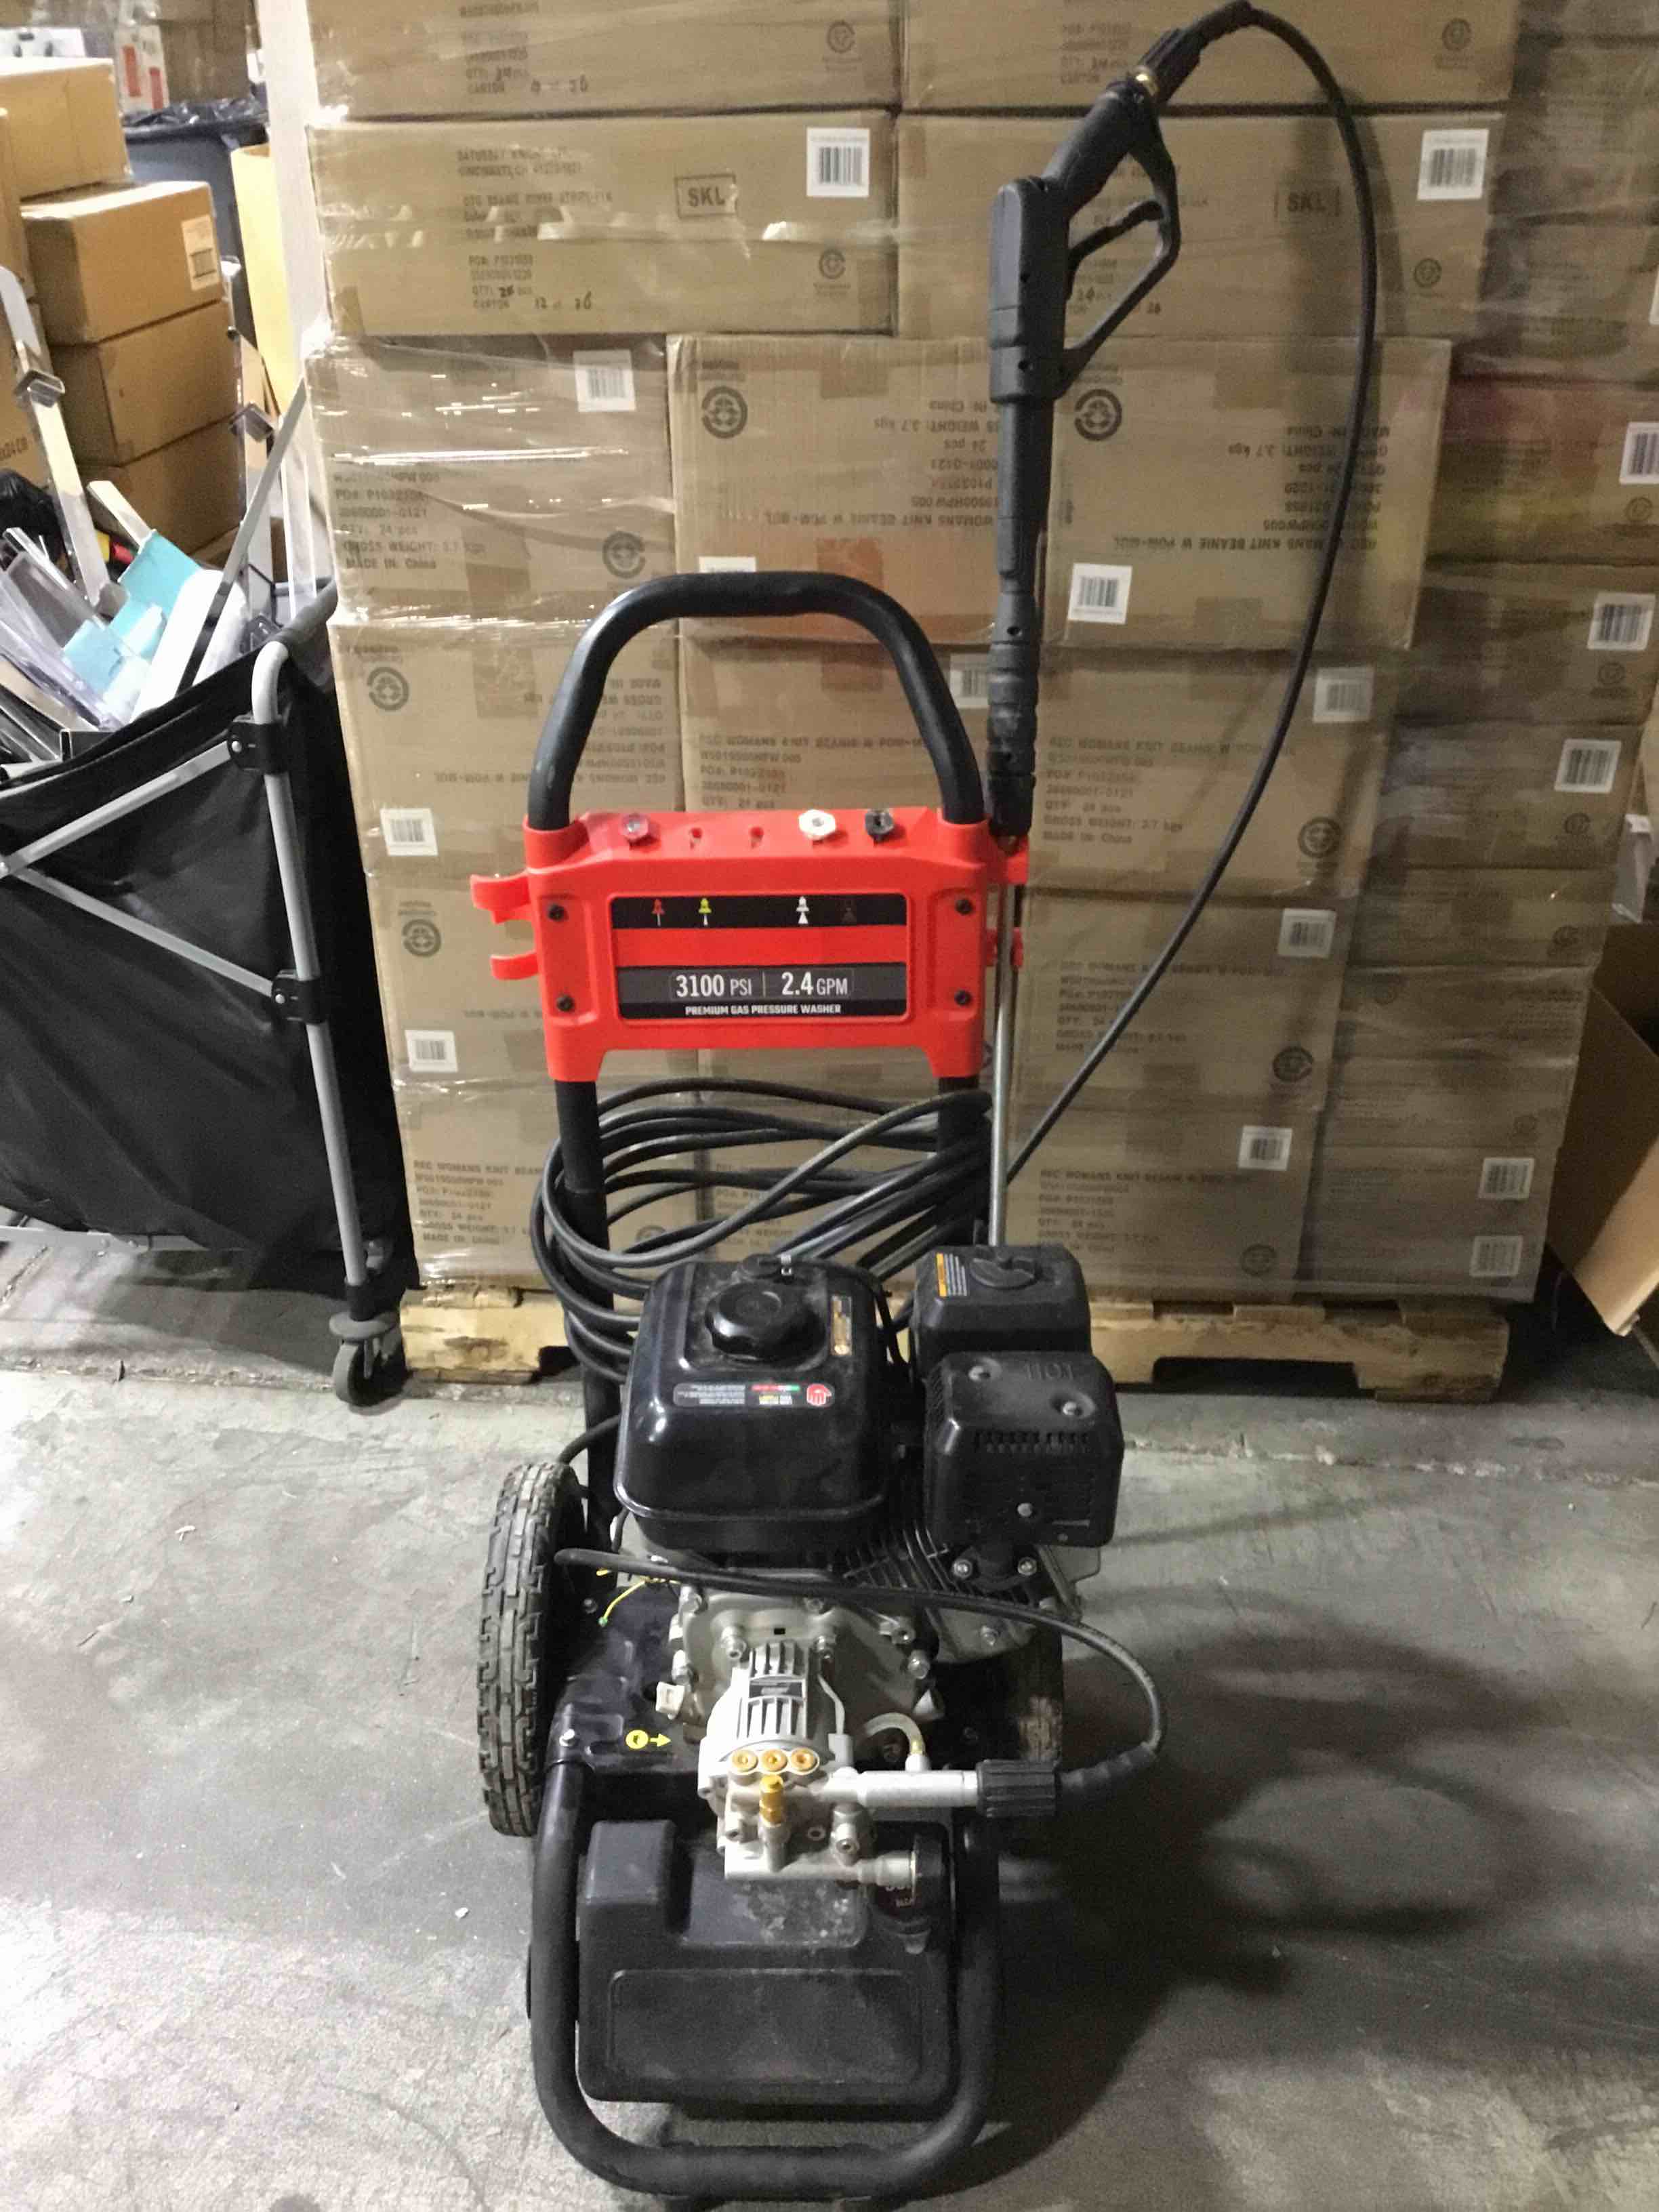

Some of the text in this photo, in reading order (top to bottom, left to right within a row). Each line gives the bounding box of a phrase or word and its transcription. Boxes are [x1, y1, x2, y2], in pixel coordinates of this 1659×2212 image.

[688, 186, 726, 207] SKL
[1286, 192, 1327, 212] SKL
[929, 401, 964, 412] China
[874, 417, 895, 431] kgs
[944, 438, 966, 451] pcs
[1227, 443, 1251, 457] kgs
[901, 514, 933, 526] KNIT
[938, 514, 993, 527] WOMANS
[1199, 537, 1246, 549] BEANIE
[1250, 537, 1280, 550] KNIT
[346, 558, 379, 569] MADE
[676, 972, 848, 998] 3100 PSI 2.4 GPM
[685, 1004, 841, 1016] PREMIUM GAS PRESSURE WASHER
[437, 1162, 481, 1173] WOMANS
